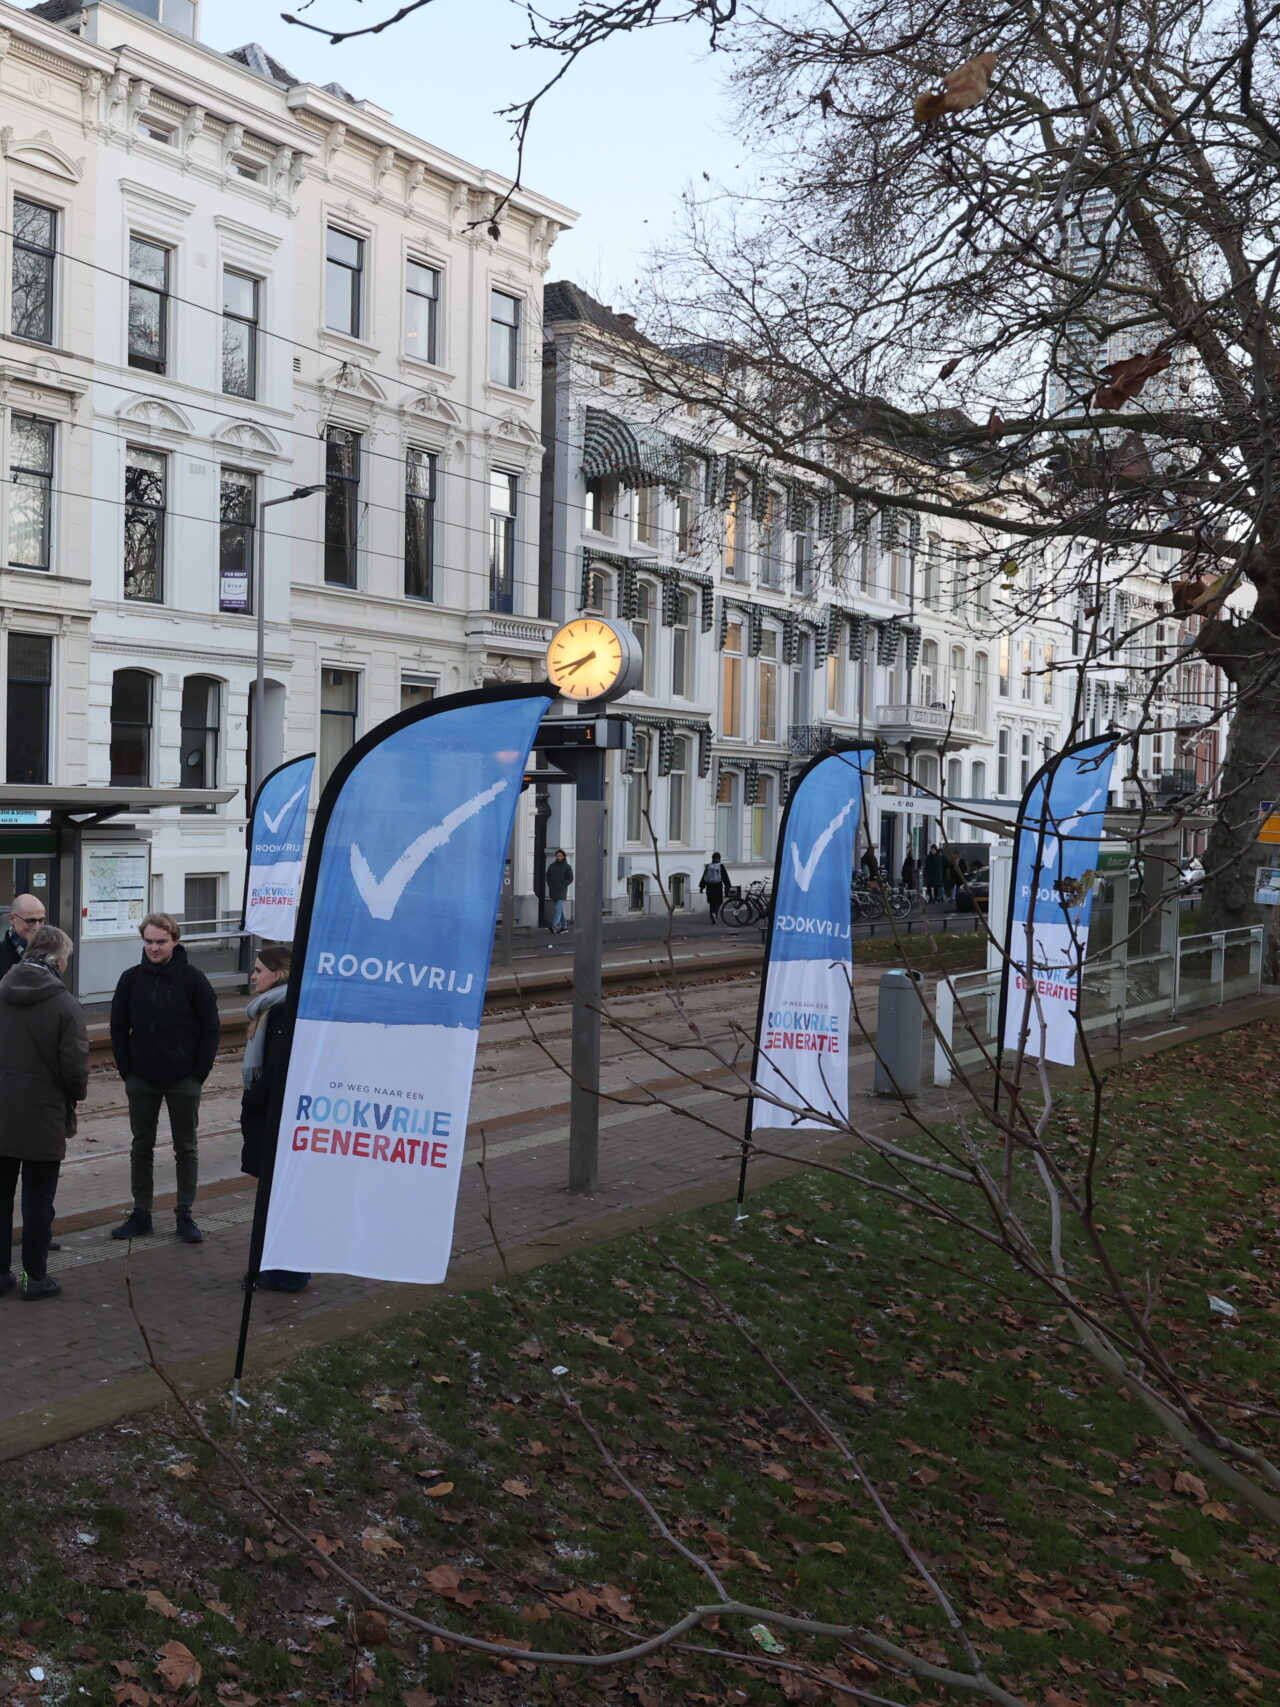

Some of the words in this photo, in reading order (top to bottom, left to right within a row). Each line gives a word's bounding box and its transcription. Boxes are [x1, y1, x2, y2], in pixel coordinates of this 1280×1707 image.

[585, 729, 592, 739] 1
[775, 915, 851, 939] ROOKVRIJ
[317, 951, 474, 995] ROOKVRIJ
[329, 1081, 344, 1089] OP
[347, 1084, 370, 1093] WEG
[374, 1087, 403, 1099] NAAR
[406, 1092, 425, 1100] EEN
[296, 1095, 452, 1136] ROOKVRIJE
[292, 1126, 448, 1168] GENERATIE
